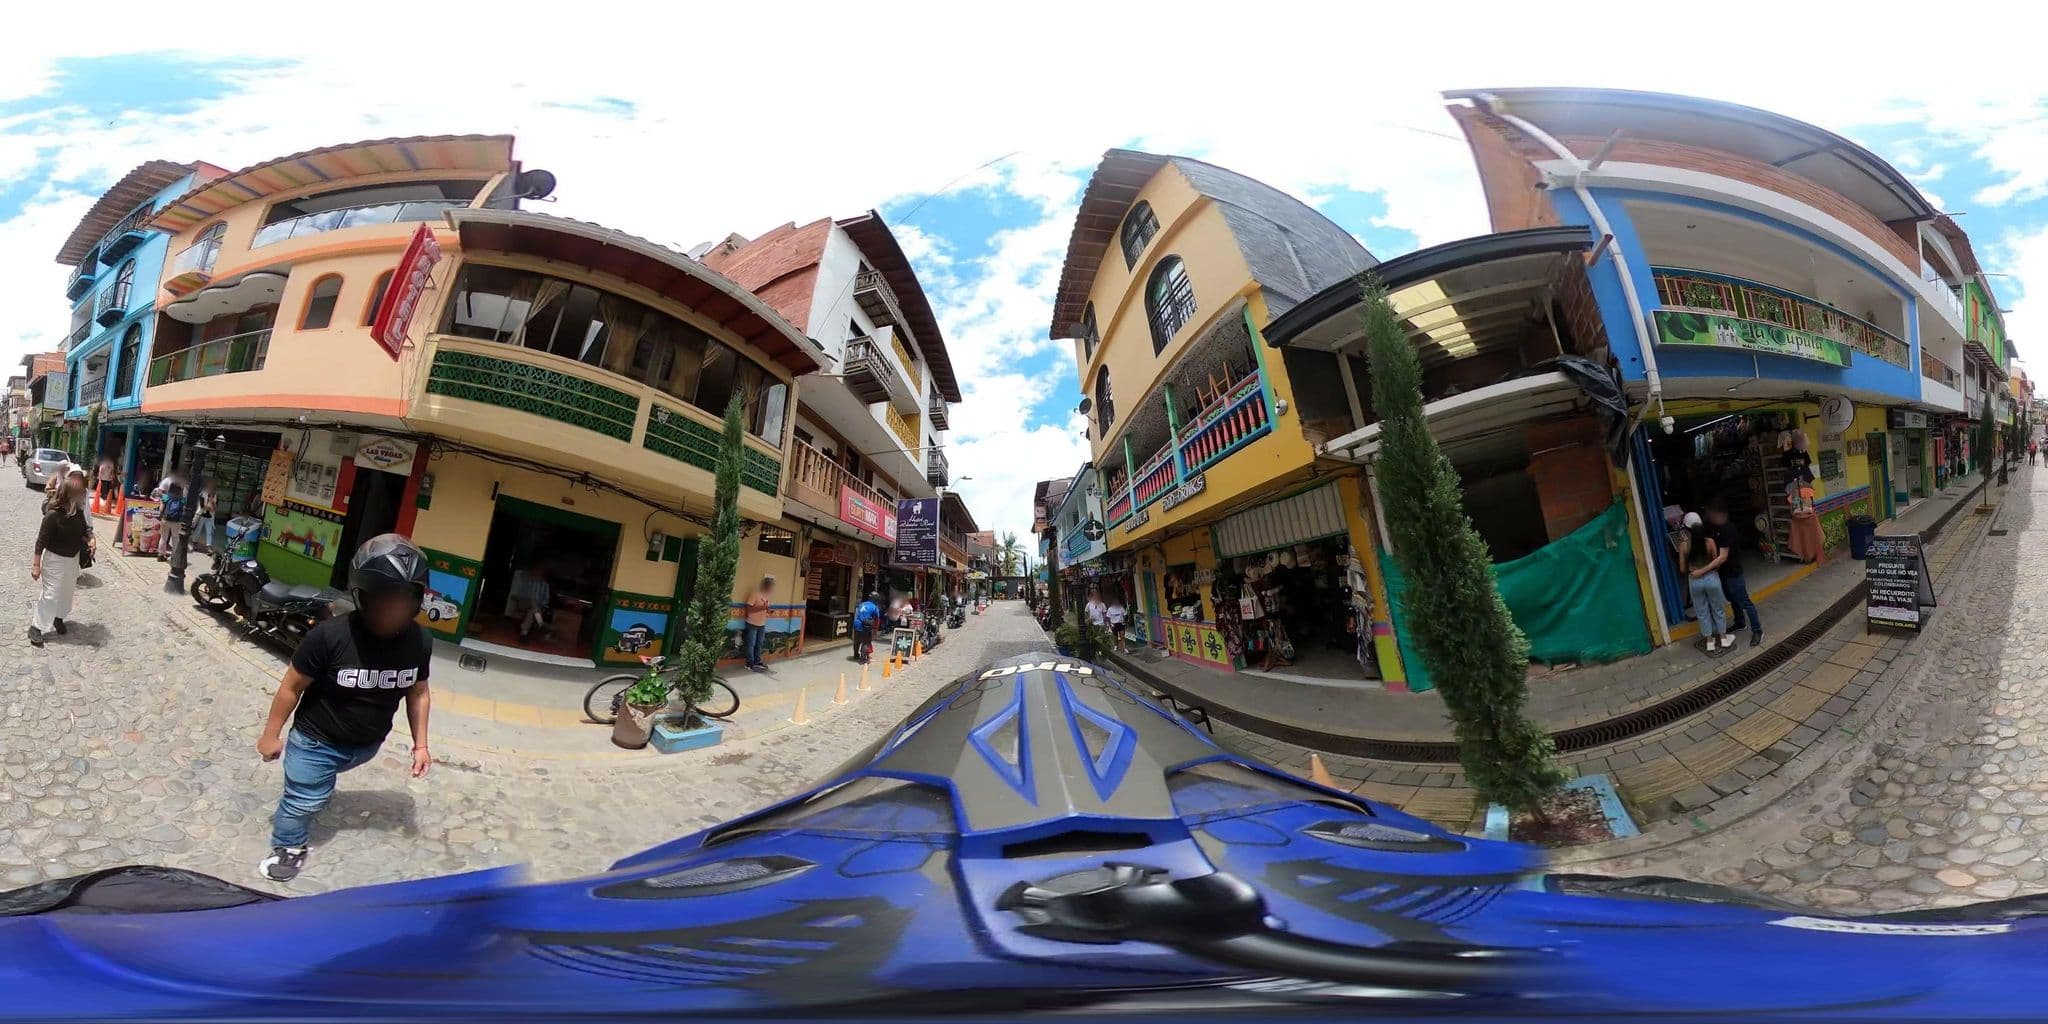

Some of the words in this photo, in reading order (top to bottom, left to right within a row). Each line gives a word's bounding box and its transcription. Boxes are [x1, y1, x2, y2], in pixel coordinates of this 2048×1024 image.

[1739, 322, 1765, 344] La
[1880, 589, 1916, 597] RECUERDITO
[336, 668, 419, 689] GUCCI
